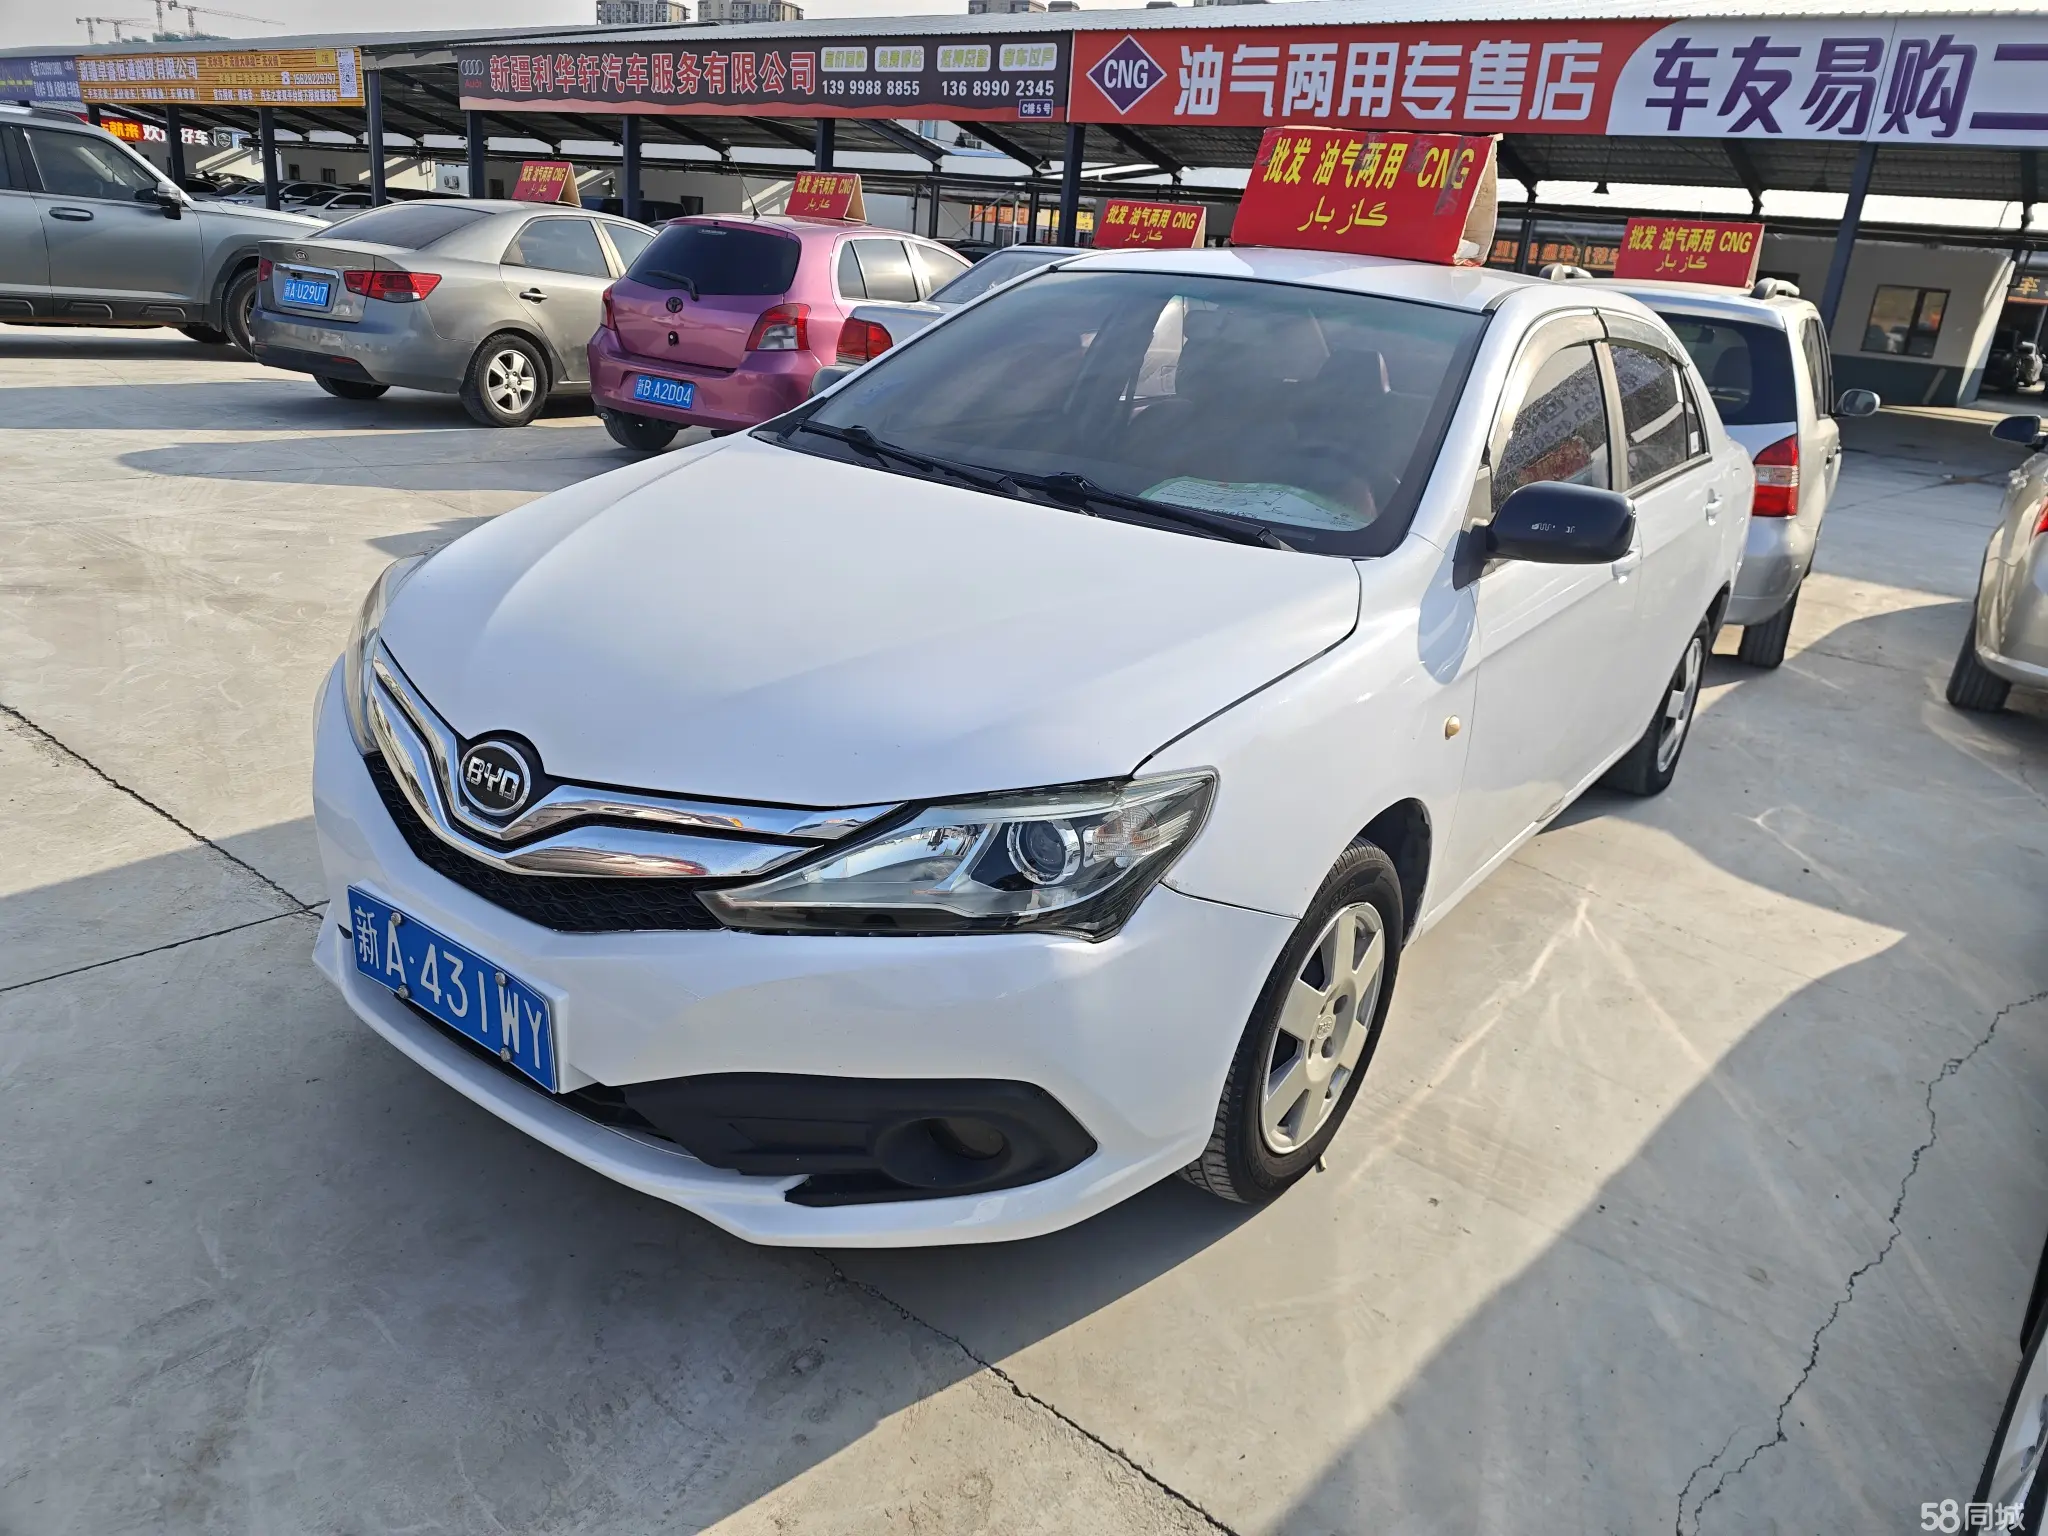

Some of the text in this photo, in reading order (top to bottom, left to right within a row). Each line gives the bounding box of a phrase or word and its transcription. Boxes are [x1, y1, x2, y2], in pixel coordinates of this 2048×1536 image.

[489, 50, 816, 95] 新疆利华轩汽车服务有限公司
[1103, 58, 1149, 89] CNG
[1175, 39, 1603, 121] 油气两用专售店
[822, 80, 920, 96] 139 9988 8855
[941, 80, 1055, 96] 136 8990 2345
[1263, 136, 1475, 190] 批发 油气两用 CNG
[796, 175, 853, 195] 批发 油气两用 CNG
[1106, 204, 1129, 225] 批发
[1129, 207, 1171, 228] 油气两用
[1172, 211, 1198, 229] CNG
[1628, 225, 1753, 253] 批发 油气两用 CNG
[465, 756, 520, 801] BYD
